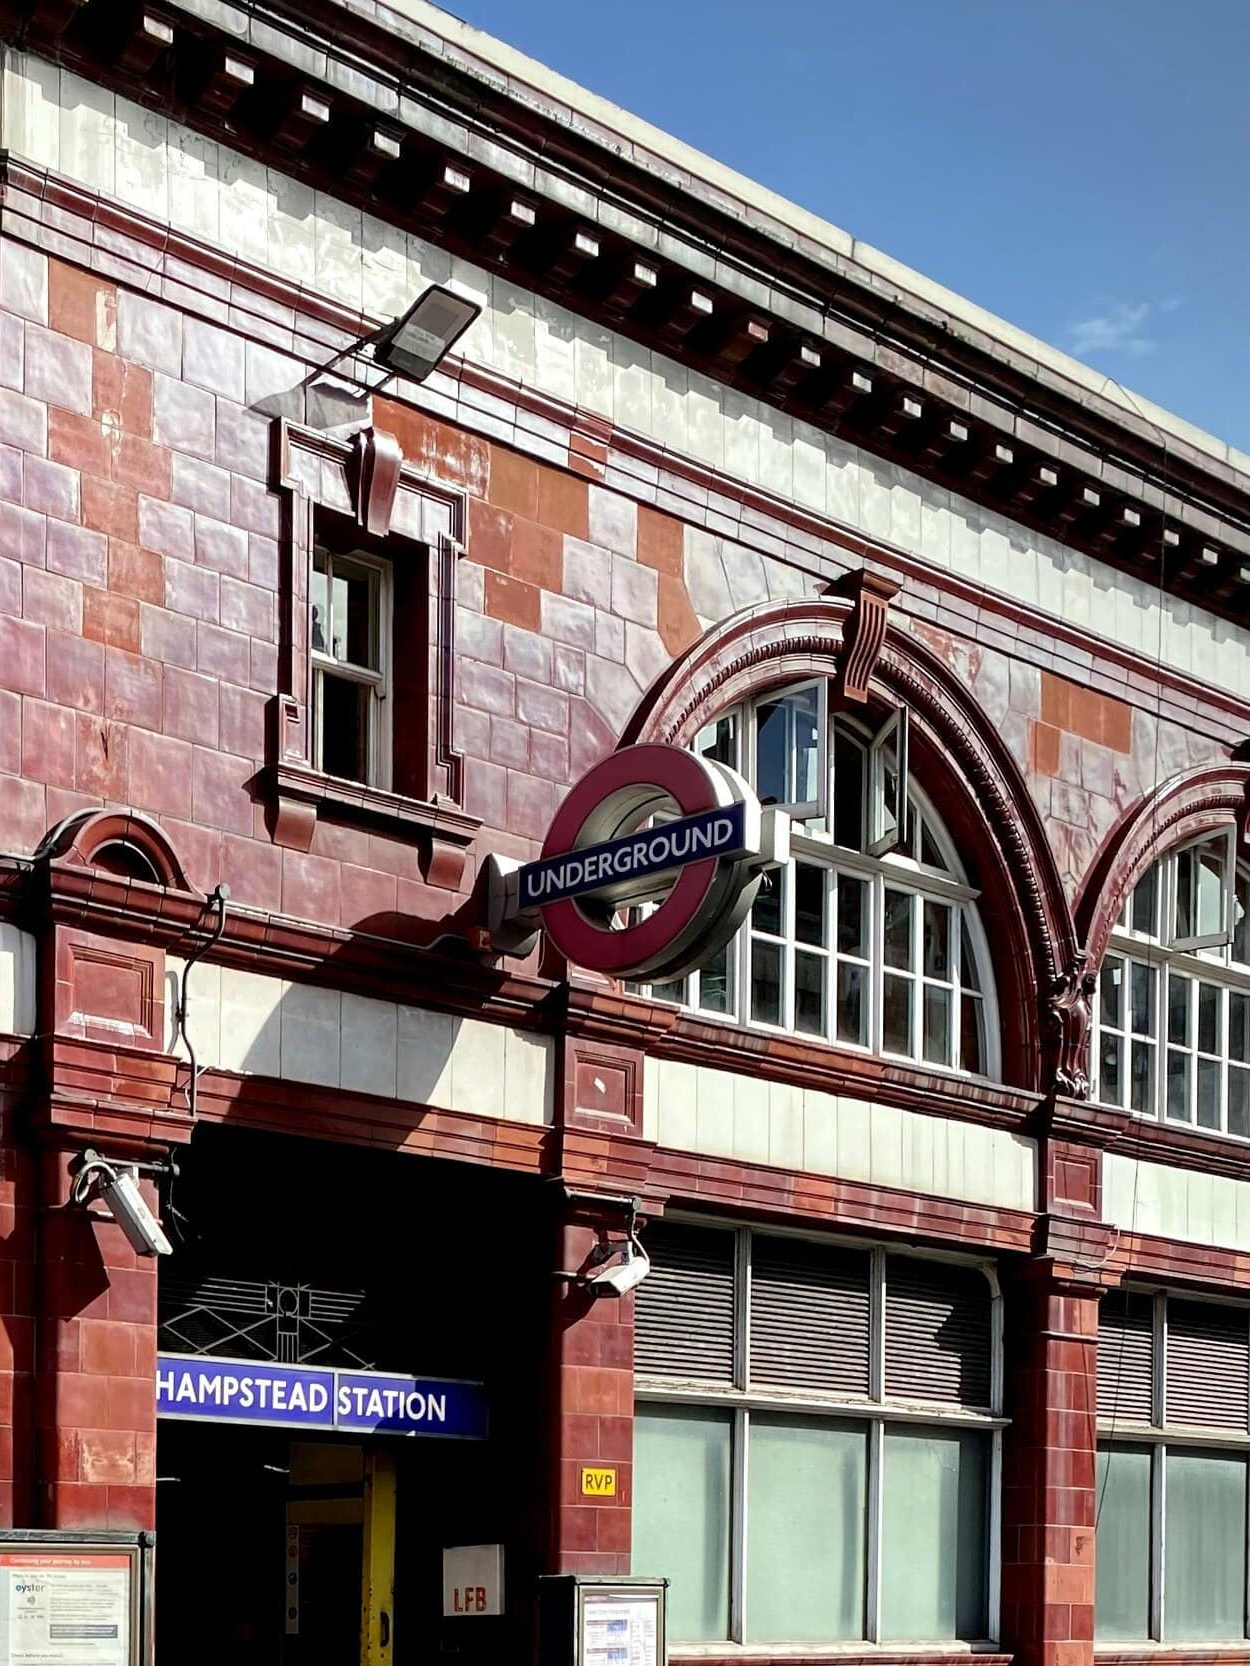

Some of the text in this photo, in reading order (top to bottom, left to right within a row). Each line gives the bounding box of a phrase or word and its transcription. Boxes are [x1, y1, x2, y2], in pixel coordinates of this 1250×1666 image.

[527, 818, 734, 898] UNDERGROUND
[156, 1368, 447, 1423] HAMPSTEAD STATION
[584, 1473, 613, 1492] RVP
[15, 1583, 46, 1593] oyster
[453, 1587, 488, 1612] LFB
